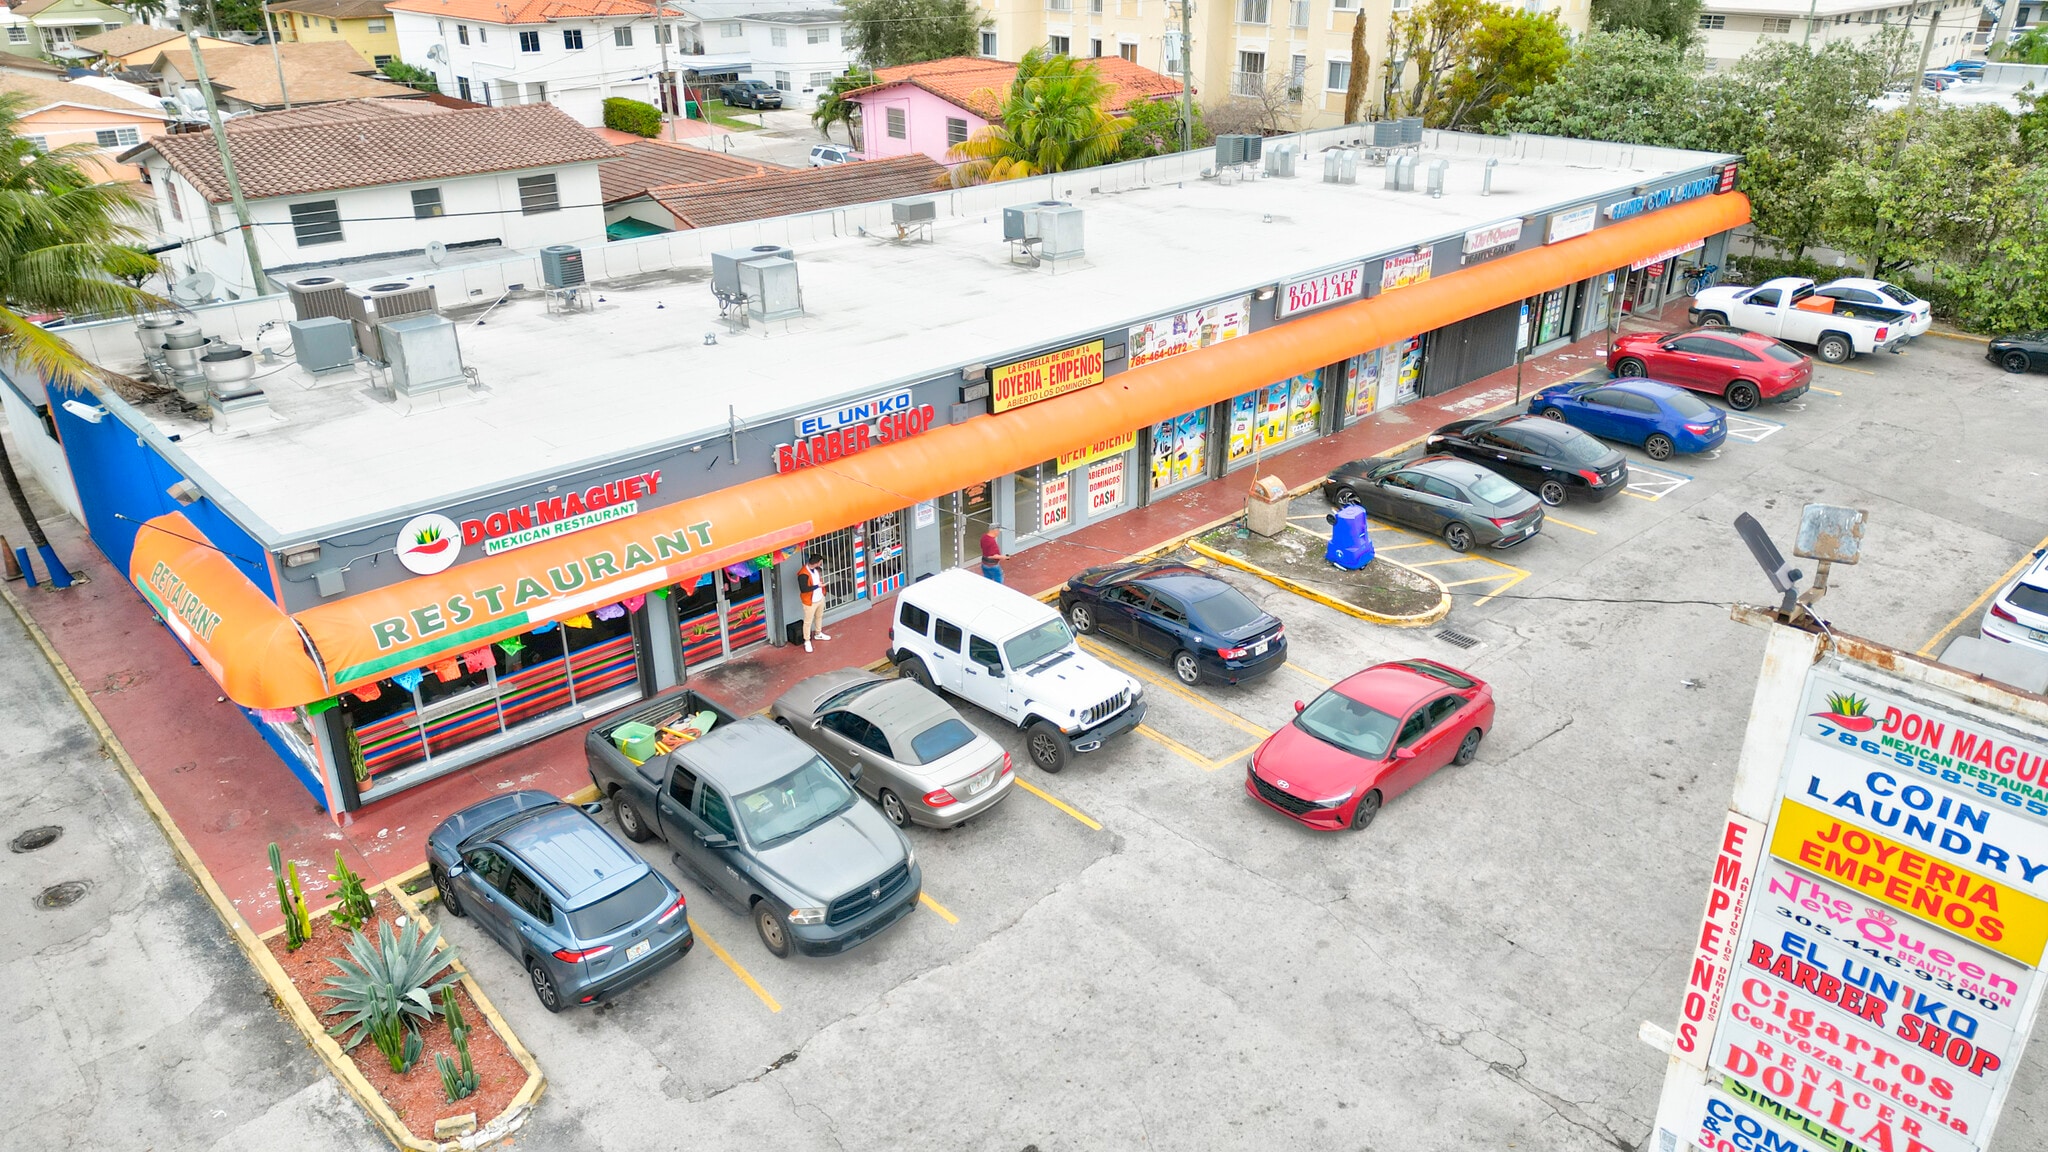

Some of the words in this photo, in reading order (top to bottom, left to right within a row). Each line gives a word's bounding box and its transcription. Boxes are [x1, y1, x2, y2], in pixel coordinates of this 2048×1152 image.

[1648, 188, 1674, 210] COIN
[1675, 174, 1720, 203] LAUNDRY
[1289, 269, 1358, 297] RENACER
[1290, 280, 1354, 311] DOLLAR
[995, 368, 1043, 401] JOYERIA
[1049, 352, 1102, 386] EMPEÑOS
[1008, 366, 1016, 374] LA
[1018, 358, 1050, 372] ESTRELLA
[1051, 354, 1060, 362] DE
[1061, 349, 1075, 359] ORO
[1082, 345, 1090, 353] 14
[1130, 342, 1188, 368] 786-464-0272
[1006, 393, 1038, 408] ABIERTO
[1040, 388, 1053, 399] LOS
[1055, 377, 1092, 393] DOMINGOS
[777, 423, 871, 473] BARBER
[877, 404, 935, 444] SHOP
[802, 417, 832, 435] EL
[461, 504, 532, 546] DON
[535, 469, 662, 522] MAGUEY
[1057, 481, 1065, 491] AM
[1059, 493, 1067, 503] PM
[1089, 475, 1120, 492] DOMINGOS
[488, 527, 550, 552] MEXICAN
[554, 502, 636, 535] RESTAURANT
[150, 560, 222, 643] RESTAURANT
[371, 521, 714, 650] RESTAURANT
[1882, 706, 1945, 750] DON
[1881, 735, 1953, 768] MEXICAN
[1956, 759, 2048, 802] RESTAURA
[1807, 775, 2048, 884] LAUNDRY
[1866, 771, 1991, 834] COIN
[1785, 870, 1853, 914] The
[1799, 840, 2005, 943] EMPEÑOS
[1816, 822, 2000, 913] JOYERIA
[1728, 877, 1749, 936] ABIERTOS
[1768, 876, 1853, 924] New
[1677, 821, 1747, 1053] EMPEÑOS
[1722, 940, 1732, 962] LOS
[1781, 931, 1828, 972] EL
[1856, 916, 2018, 996] Queen
[1707, 967, 1727, 1021] DOMINGOS
[1898, 950, 1956, 982] BEAUTY
[1959, 978, 2012, 1007] SALON
[1748, 940, 1888, 1028] BARBER
[1897, 1012, 2001, 1078] SHOP
[1741, 978, 1955, 1101] Cigarros
[1731, 1002, 1968, 1135] Cerveza-Lotería
[1755, 1039, 1923, 1138] RENACER
[1703, 1116, 1722, 1136] &
[1707, 1098, 1811, 1152] COM
[1732, 1080, 1838, 1148] SIMPLE
